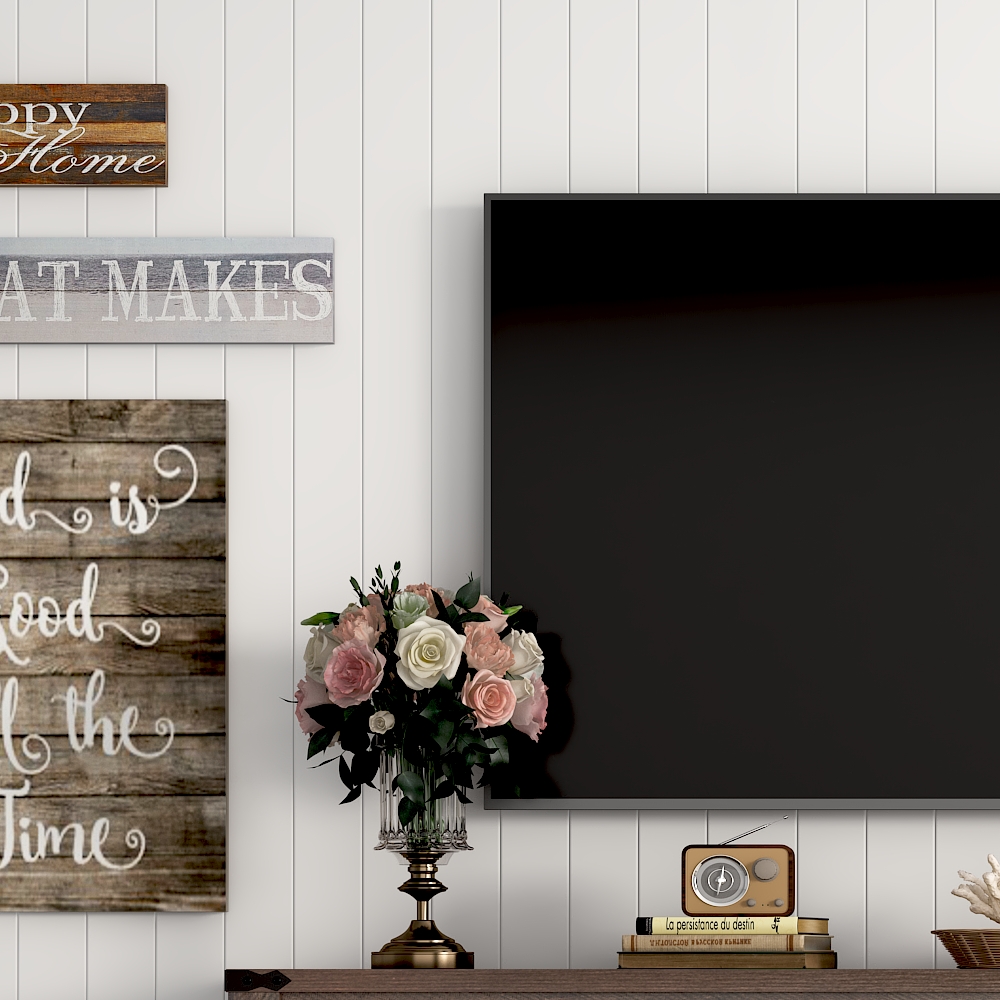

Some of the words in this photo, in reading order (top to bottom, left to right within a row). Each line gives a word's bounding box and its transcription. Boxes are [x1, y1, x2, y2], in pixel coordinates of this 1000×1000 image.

[0, 126, 166, 174] Home
[0, 260, 80, 322] AT
[100, 258, 334, 322] MAKES
[109, 444, 198, 534] is
[0, 562, 160, 664] ood
[51, 668, 175, 758] the
